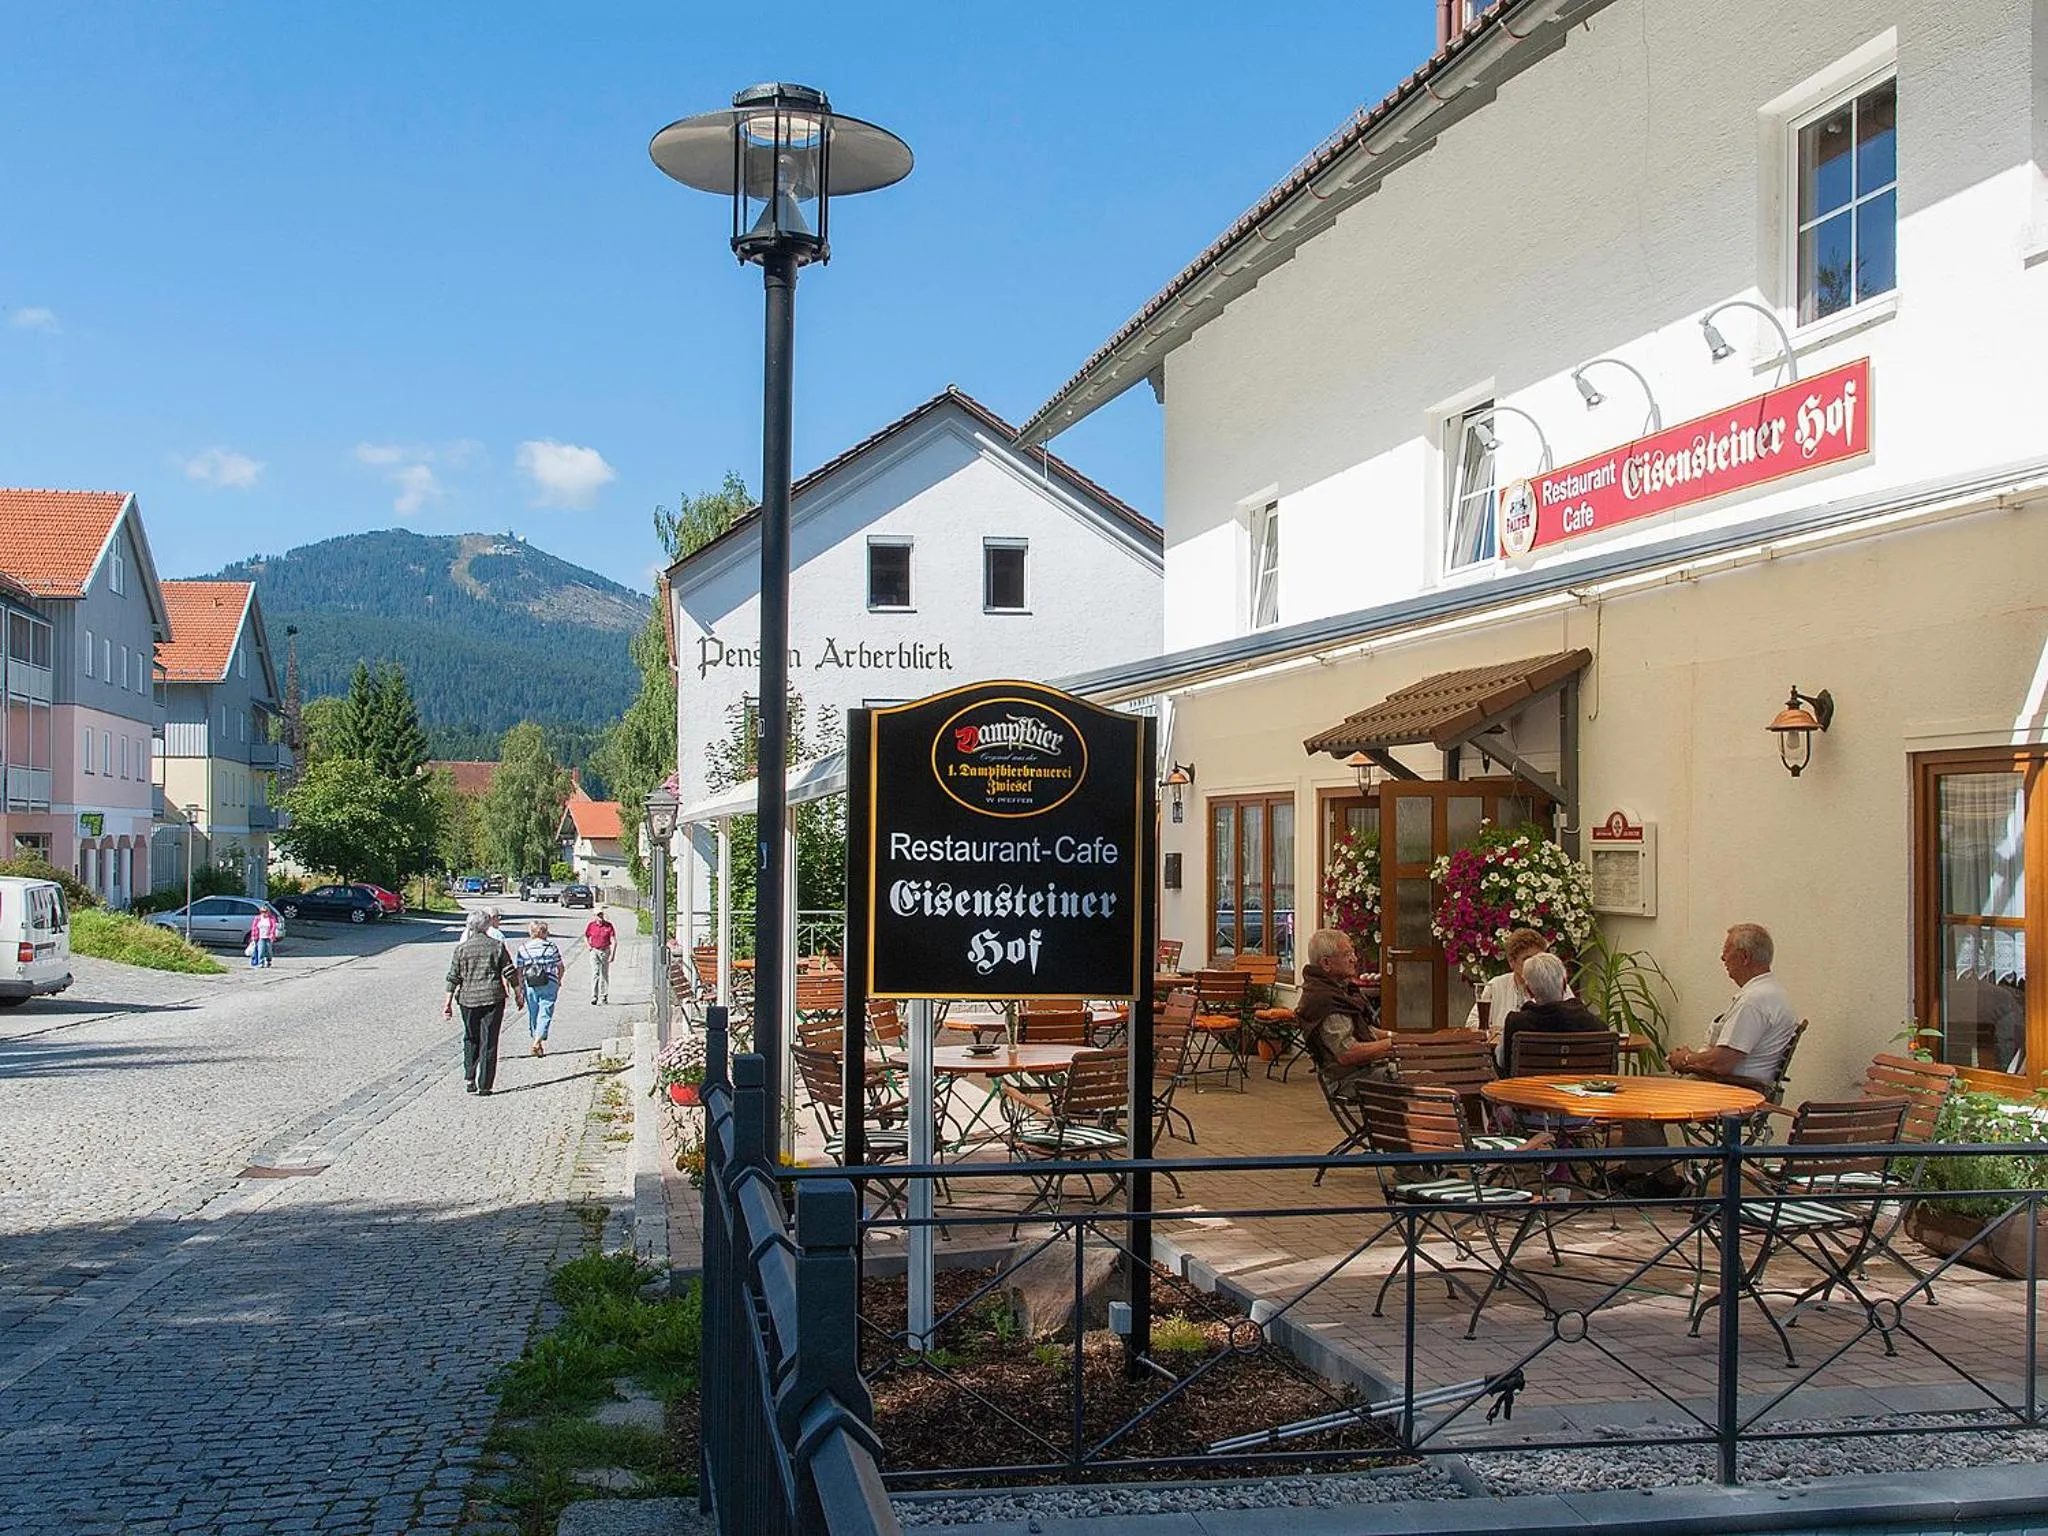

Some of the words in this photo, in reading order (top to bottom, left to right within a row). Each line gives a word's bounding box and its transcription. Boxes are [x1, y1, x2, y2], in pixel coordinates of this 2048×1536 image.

[1621, 420, 1787, 500] Eisensteiner
[1794, 379, 1857, 459] Hof
[1541, 458, 1617, 507] Restaurant
[1562, 501, 1595, 533] Cafe
[697, 636, 802, 680] Pensn
[815, 637, 953, 671] Arberblick
[955, 713, 1064, 755] Dampfbier
[948, 763, 957, 776] 1.
[959, 763, 1073, 779] Dampfbierbrauerei
[986, 778, 1033, 795] Zwiesel
[890, 832, 1118, 863] Restaurant-Cafe
[889, 879, 1117, 918] Eisensteiner
[967, 928, 1043, 975] Hof
